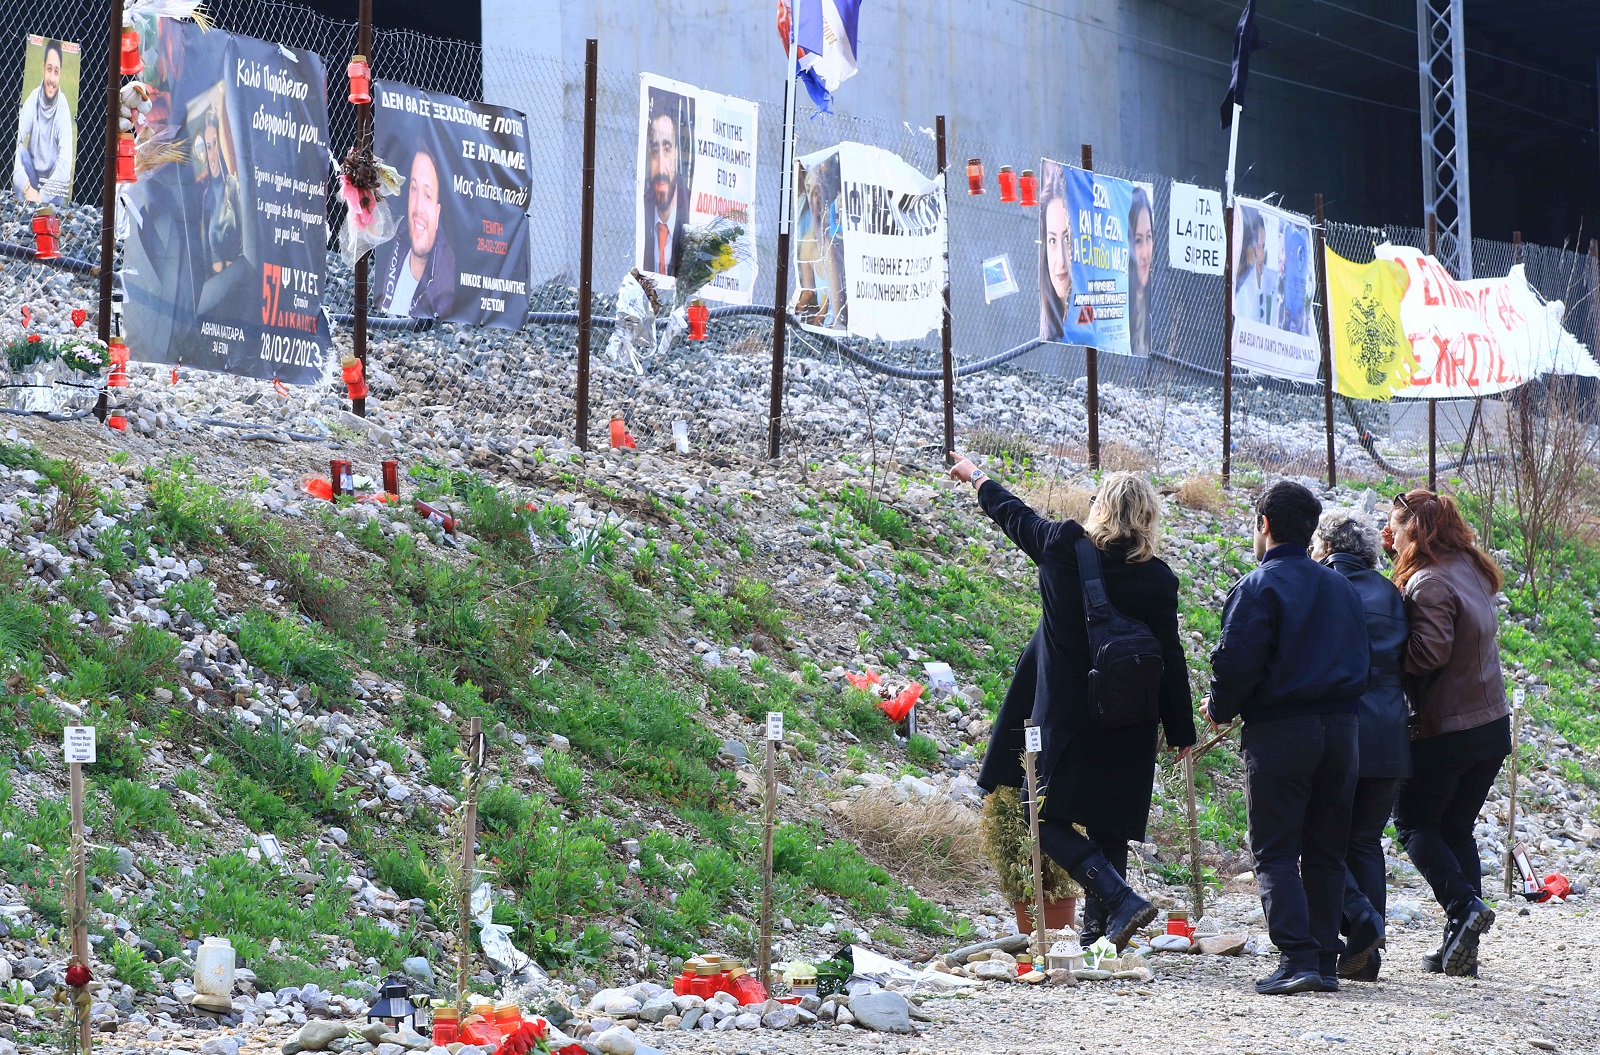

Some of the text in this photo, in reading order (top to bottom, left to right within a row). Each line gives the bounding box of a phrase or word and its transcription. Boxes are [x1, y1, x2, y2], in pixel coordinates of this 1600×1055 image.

[237, 57, 309, 102] Καλό Παράδεισο
[381, 91, 404, 111] ΔΕΝ
[405, 95, 418, 115] ΘΑ
[419, 99, 431, 118] ΣΕ
[432, 102, 493, 131] ΞΕΧΑΣΟΥΜΕ
[252, 103, 326, 154] αδερφούλα μου...
[462, 139, 476, 159] ΣΕ
[453, 174, 528, 207] Μας λείπεις πολύ
[482, 219, 504, 237] ΤΕΜΠΗ
[1079, 209, 1092, 236] ΚΑΙ
[1176, 218, 1193, 237] LA
[476, 237, 509, 256] 28-02-2023
[1073, 237, 1080, 263] Η
[1080, 234, 1111, 270] Ελπίδα
[460, 272, 481, 289] ΝΙΚΟΣ
[261, 262, 319, 327] 57 ΨΥΧΕΣ
[487, 298, 505, 313] ΕΤΩΝ
[201, 321, 220, 339] ΑΘΗΝΑ
[1239, 330, 1247, 346] ΘΑ
[260, 332, 323, 368] 28/02/2023
